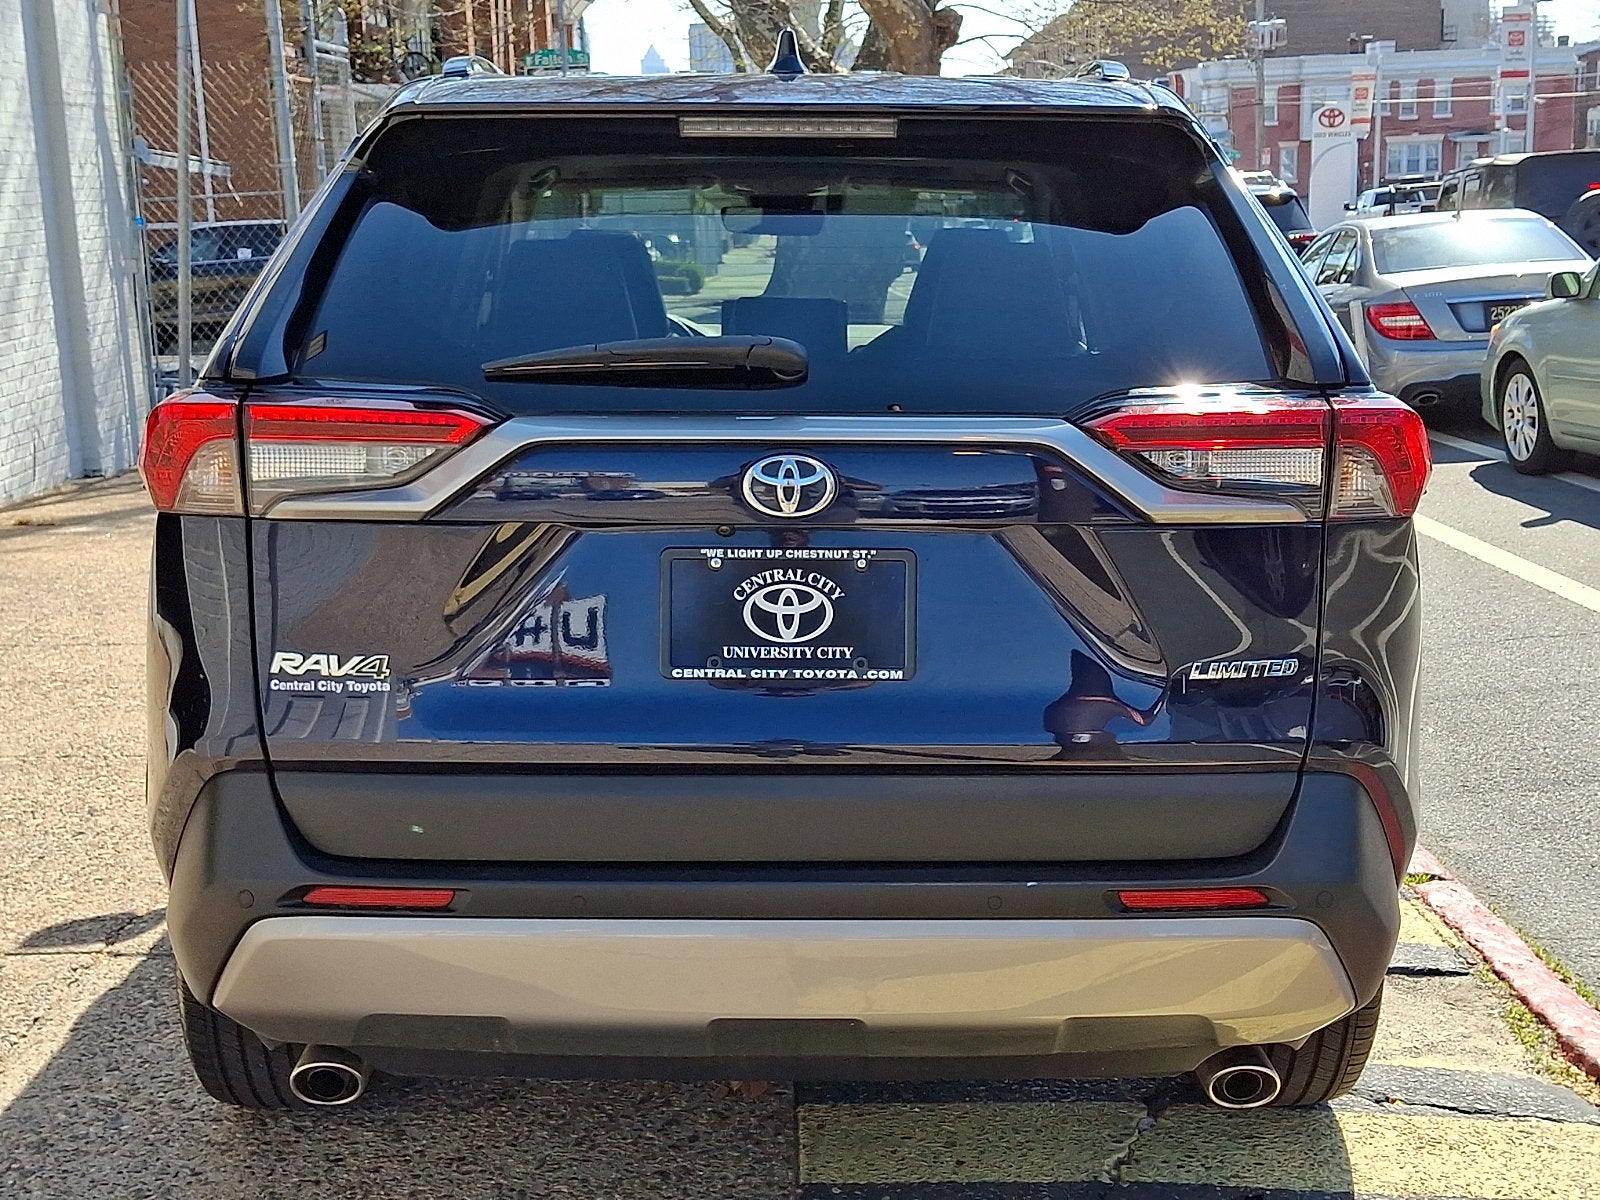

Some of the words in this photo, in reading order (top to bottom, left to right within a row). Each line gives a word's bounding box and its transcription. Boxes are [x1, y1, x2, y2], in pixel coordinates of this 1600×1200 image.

[727, 549, 764, 559] LIGHT
[765, 549, 783, 558] UP
[785, 549, 849, 559] CHESTNUT
[733, 568, 806, 601] CENTRAL
[808, 572, 846, 601] CITY
[723, 646, 814, 659] UNIVERSITY
[816, 646, 854, 659] CITY
[269, 651, 391, 680] RAV4
[1188, 658, 1299, 680] LIMITED
[671, 668, 747, 679] CENTRAL
[750, 668, 788, 679] CITY
[792, 669, 857, 680] TOYOTA
[269, 679, 315, 692] Central
[317, 680, 344, 694] City
[346, 680, 391, 694] Toyota
